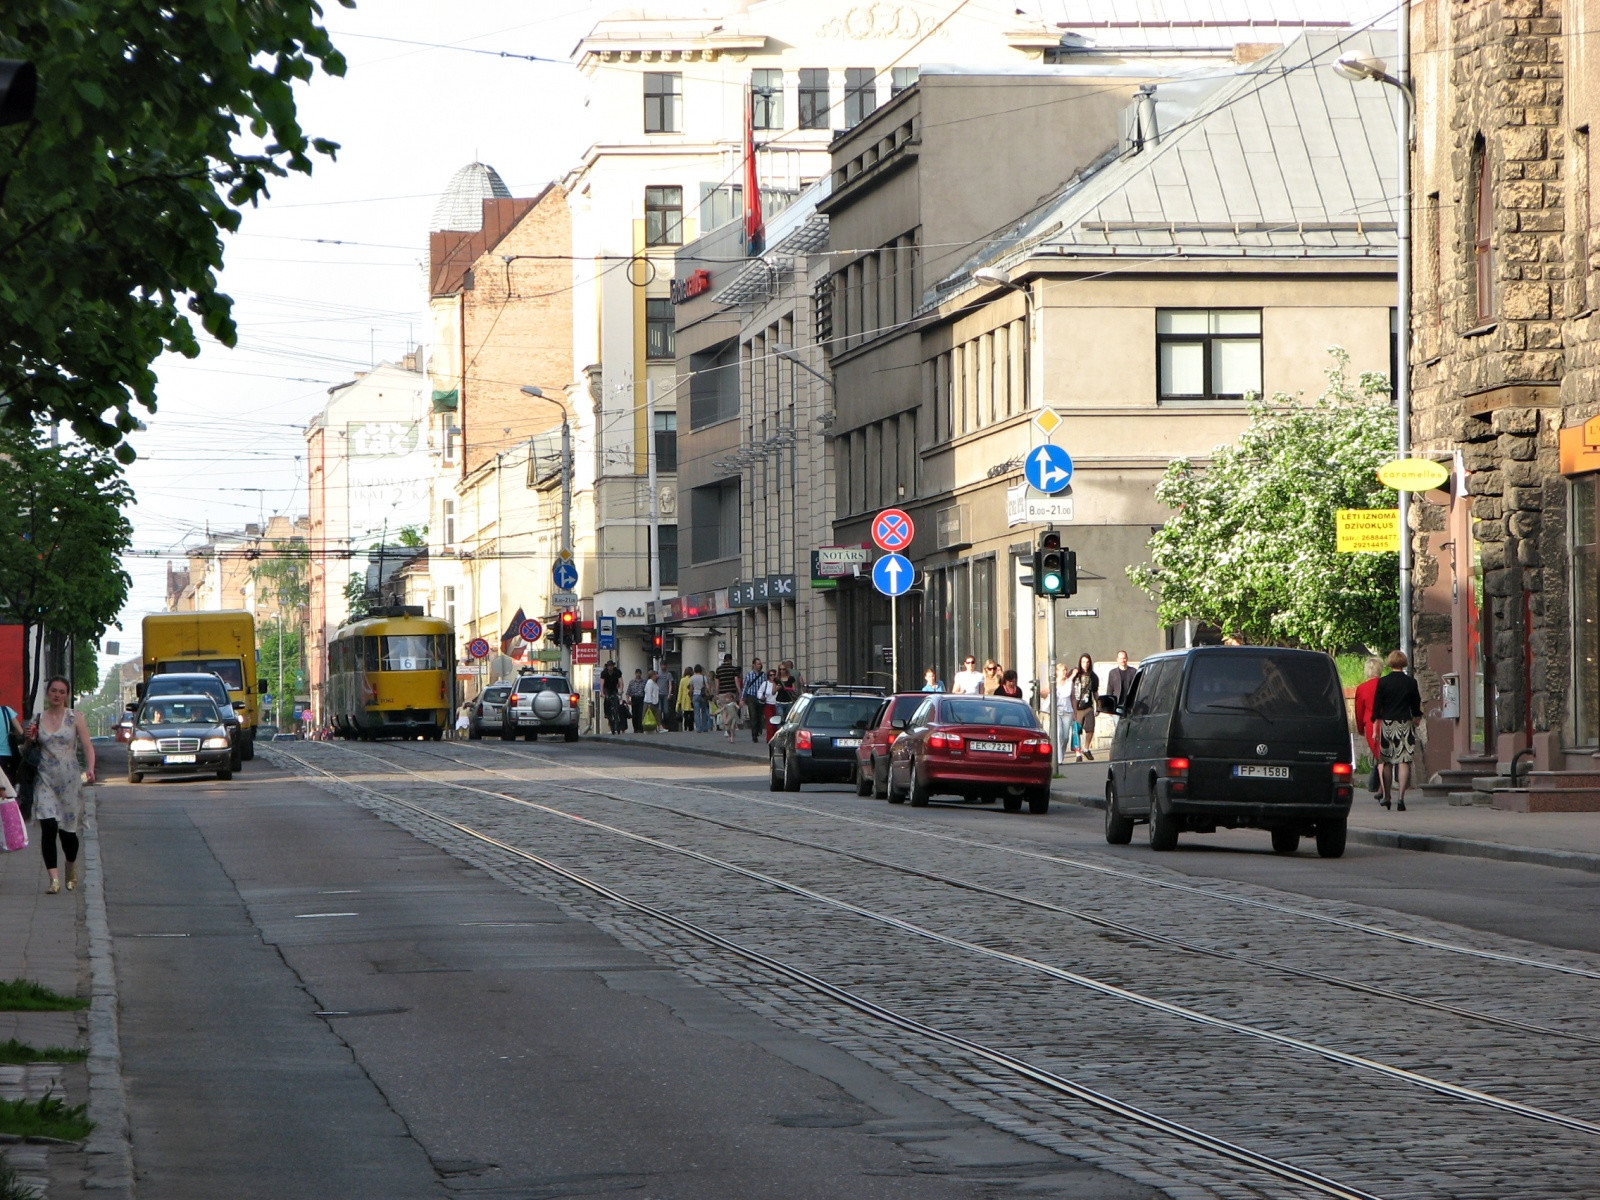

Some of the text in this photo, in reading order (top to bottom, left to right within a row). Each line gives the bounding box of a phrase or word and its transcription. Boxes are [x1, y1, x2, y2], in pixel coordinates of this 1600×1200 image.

[1383, 469, 1442, 478] caramelles
[1363, 512, 1396, 520] IZNOMĀ
[1345, 522, 1394, 530] DZĪVOKĻUS
[823, 550, 865, 560] NOTĀRS
[404, 658, 412, 669] 6
[975, 740, 1012, 752] EK-7221
[1240, 766, 1288, 777] FP-1588
